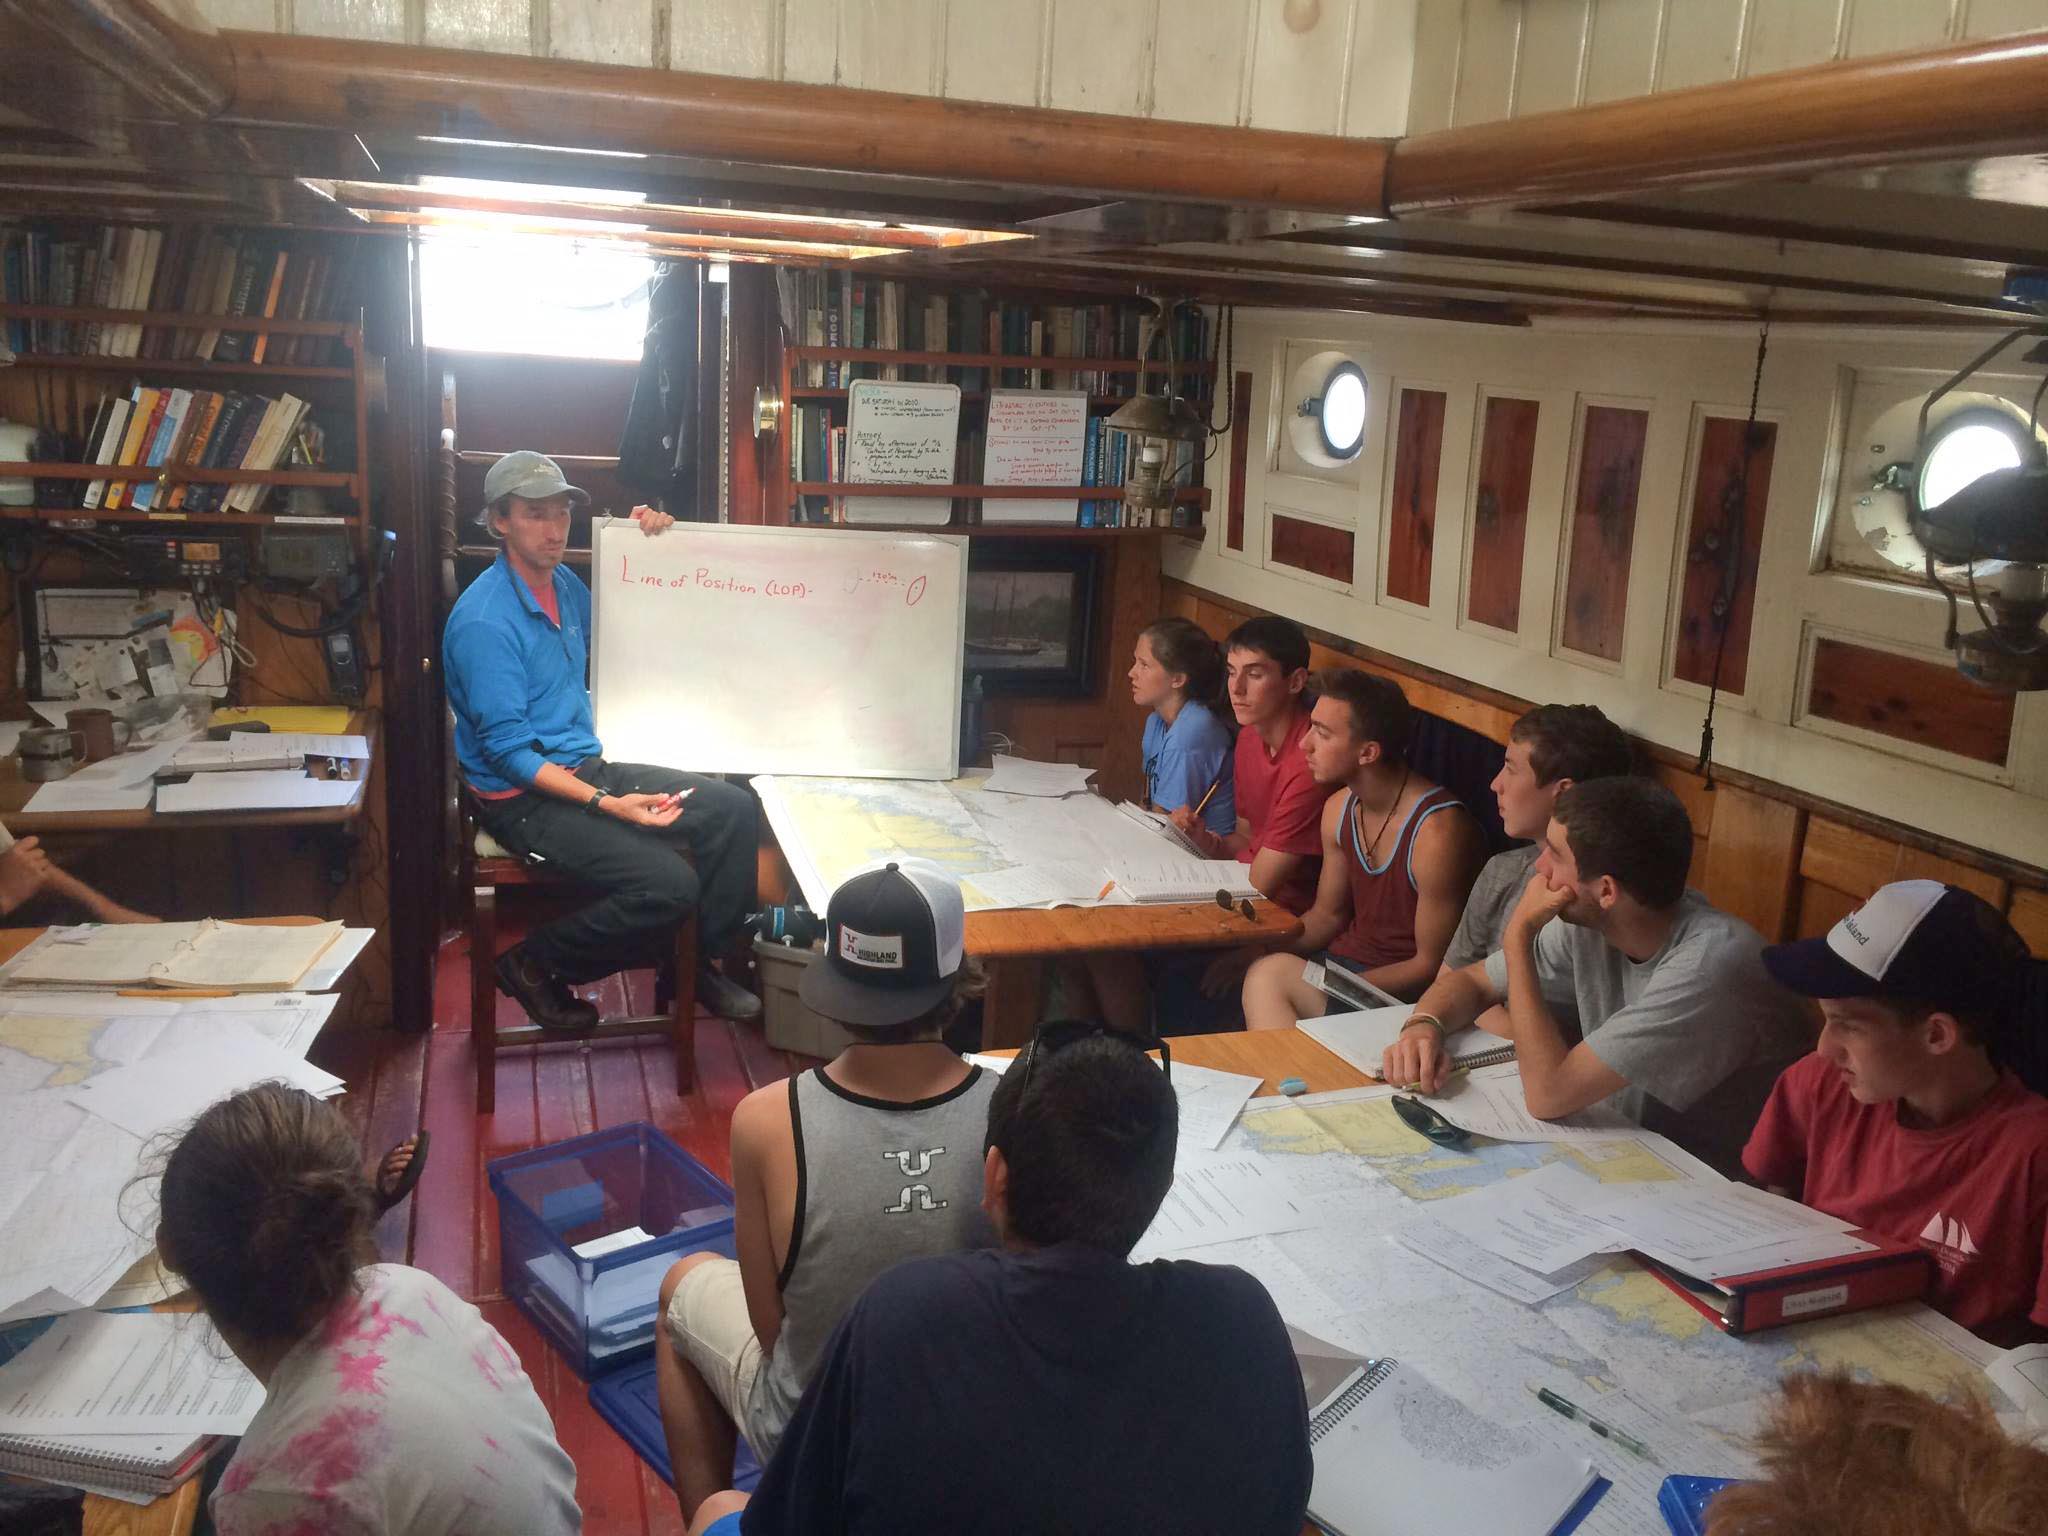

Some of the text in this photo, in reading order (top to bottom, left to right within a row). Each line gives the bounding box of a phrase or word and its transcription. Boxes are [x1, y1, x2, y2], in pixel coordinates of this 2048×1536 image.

[621, 554, 664, 588] Line
[670, 573, 688, 588] of
[695, 567, 757, 595] Position
[858, 949, 898, 961] HIGHLAND
